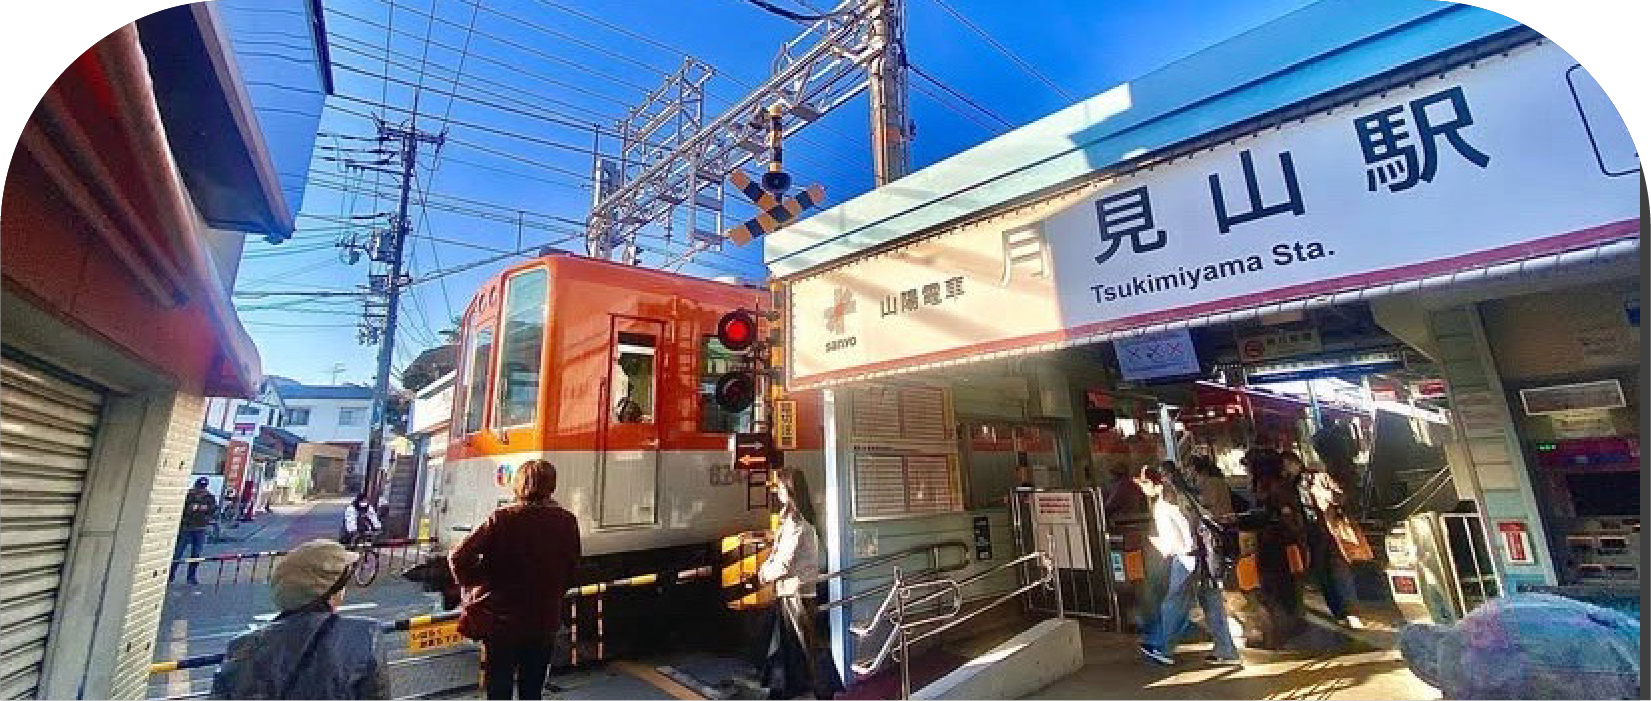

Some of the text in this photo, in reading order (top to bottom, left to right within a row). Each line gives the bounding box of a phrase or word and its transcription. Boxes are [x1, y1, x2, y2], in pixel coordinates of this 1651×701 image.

[1000, 85, 1490, 288] 月見山駅
[880, 277, 965, 319] 山陽電車
[1091, 240, 1335, 304] Tsukimiyama Sta.
[826, 336, 857, 353] sanyo
